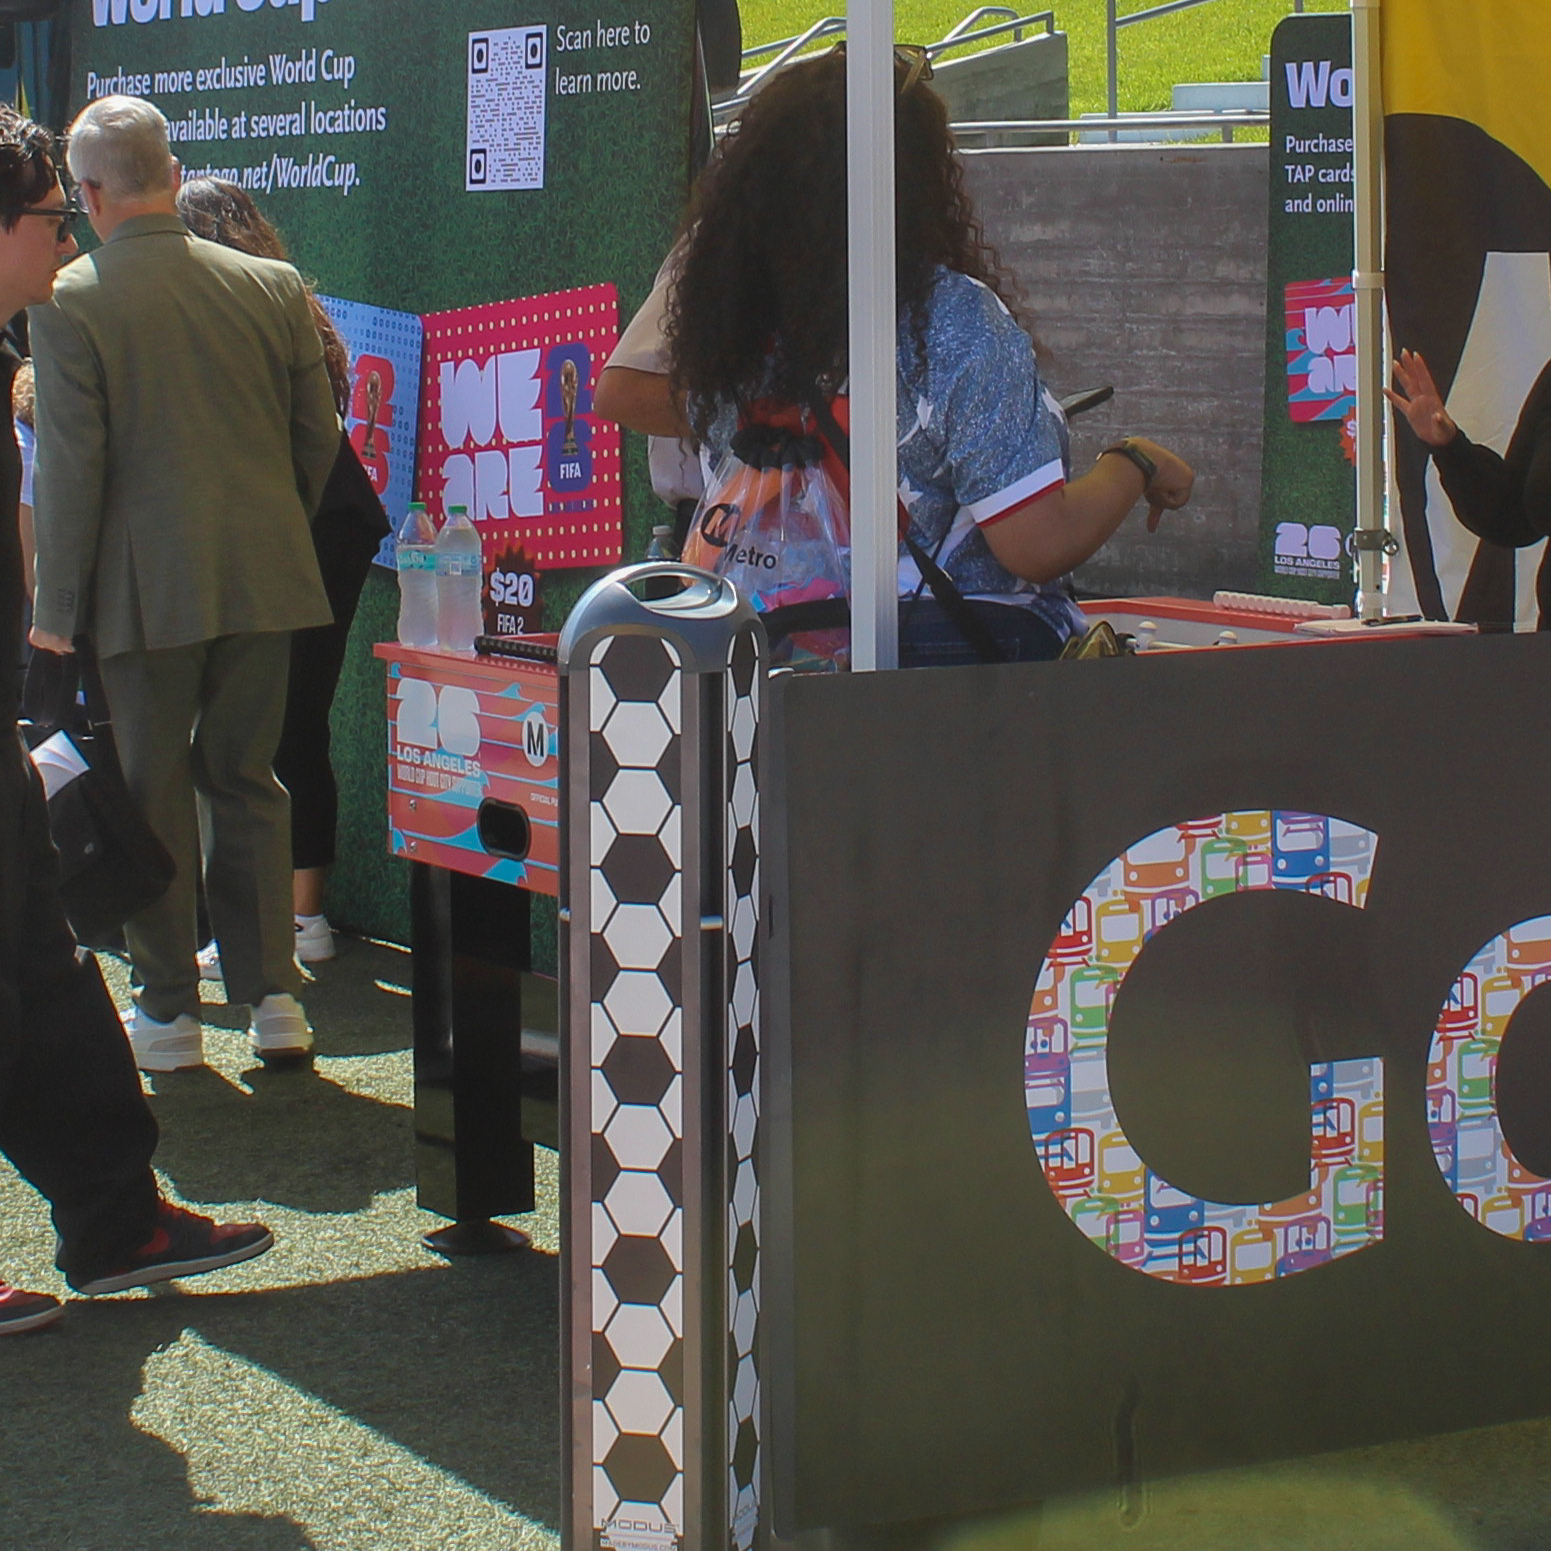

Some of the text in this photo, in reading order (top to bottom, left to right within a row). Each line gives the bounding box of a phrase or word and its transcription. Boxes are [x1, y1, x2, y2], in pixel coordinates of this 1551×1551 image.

[556, 19, 651, 52] Scan here to
[87, 48, 356, 99] Purchase more exclusive World Cup
[556, 67, 641, 95] learn more.
[231, 115, 247, 140] at
[250, 100, 305, 139] several
[310, 99, 386, 135] locations
[1286, 133, 1354, 153] Purchase
[1285, 164, 1315, 184] TAP
[1285, 192, 1353, 213] and onlin
[440, 348, 543, 449] WE
[559, 462, 582, 479] FIFA
[724, 544, 777, 569] Metro
[1274, 556, 1340, 570] LOS ANGELES
[489, 567, 535, 608] $20
[497, 613, 516, 633] FIFA
[396, 745, 481, 778] LOS ANGELES
[601, 1518, 677, 1534] MODUS
